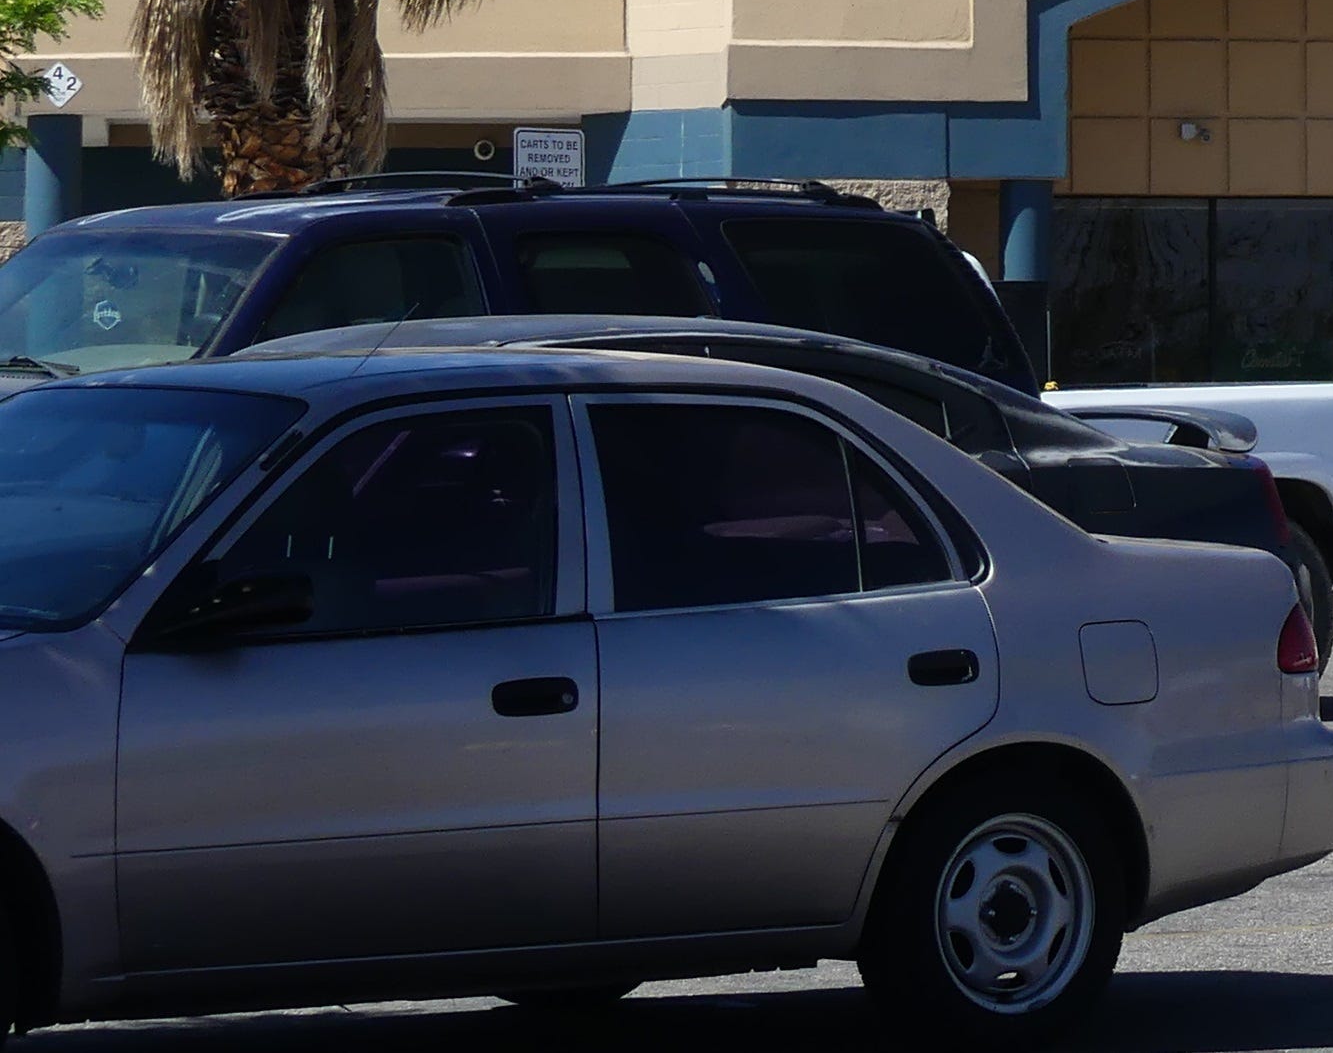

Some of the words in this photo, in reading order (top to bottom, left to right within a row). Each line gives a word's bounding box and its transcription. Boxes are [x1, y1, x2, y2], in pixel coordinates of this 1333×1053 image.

[52, 66, 64, 80] 4
[66, 76, 77, 91] 2
[520, 139, 549, 150] CARTS
[552, 140, 563, 150] TO
[566, 140, 578, 150] BE
[527, 153, 571, 164] REMOVED
[520, 166, 537, 177] AND
[541, 167, 553, 177] OR
[557, 168, 578, 177] KEPT
